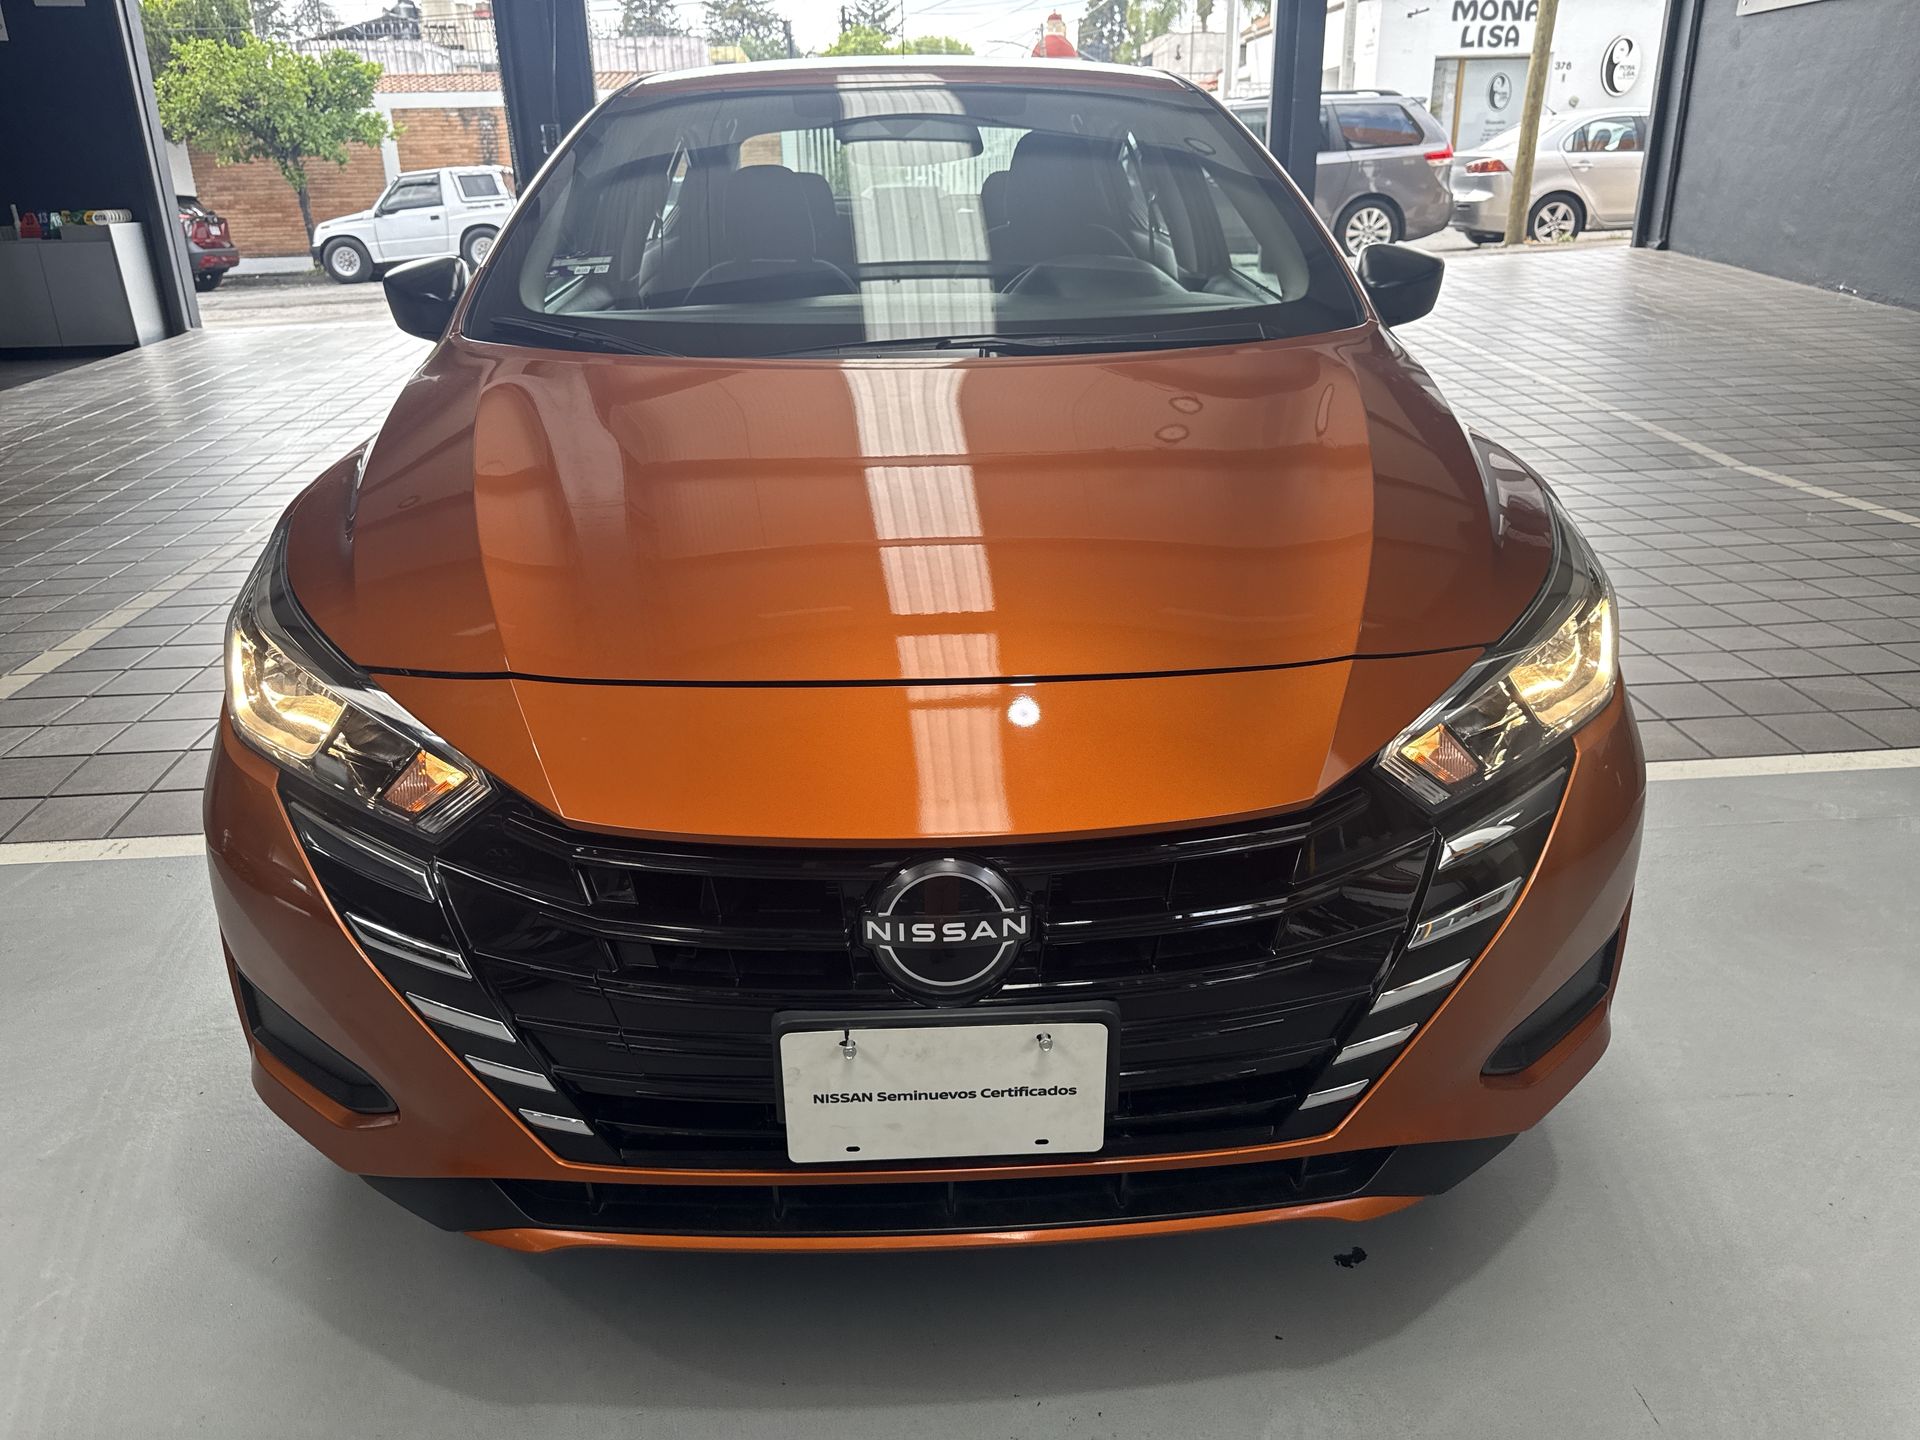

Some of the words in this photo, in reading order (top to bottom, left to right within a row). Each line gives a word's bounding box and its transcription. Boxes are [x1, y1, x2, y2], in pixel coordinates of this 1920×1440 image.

[1452, 0, 1538, 21] MONA
[1461, 25, 1519, 48] LISA
[866, 915, 1026, 942] NISSAN
[813, 1092, 873, 1104] NISSAN
[877, 1089, 977, 1102] Seminuevos
[980, 1085, 1077, 1098] Certificados
